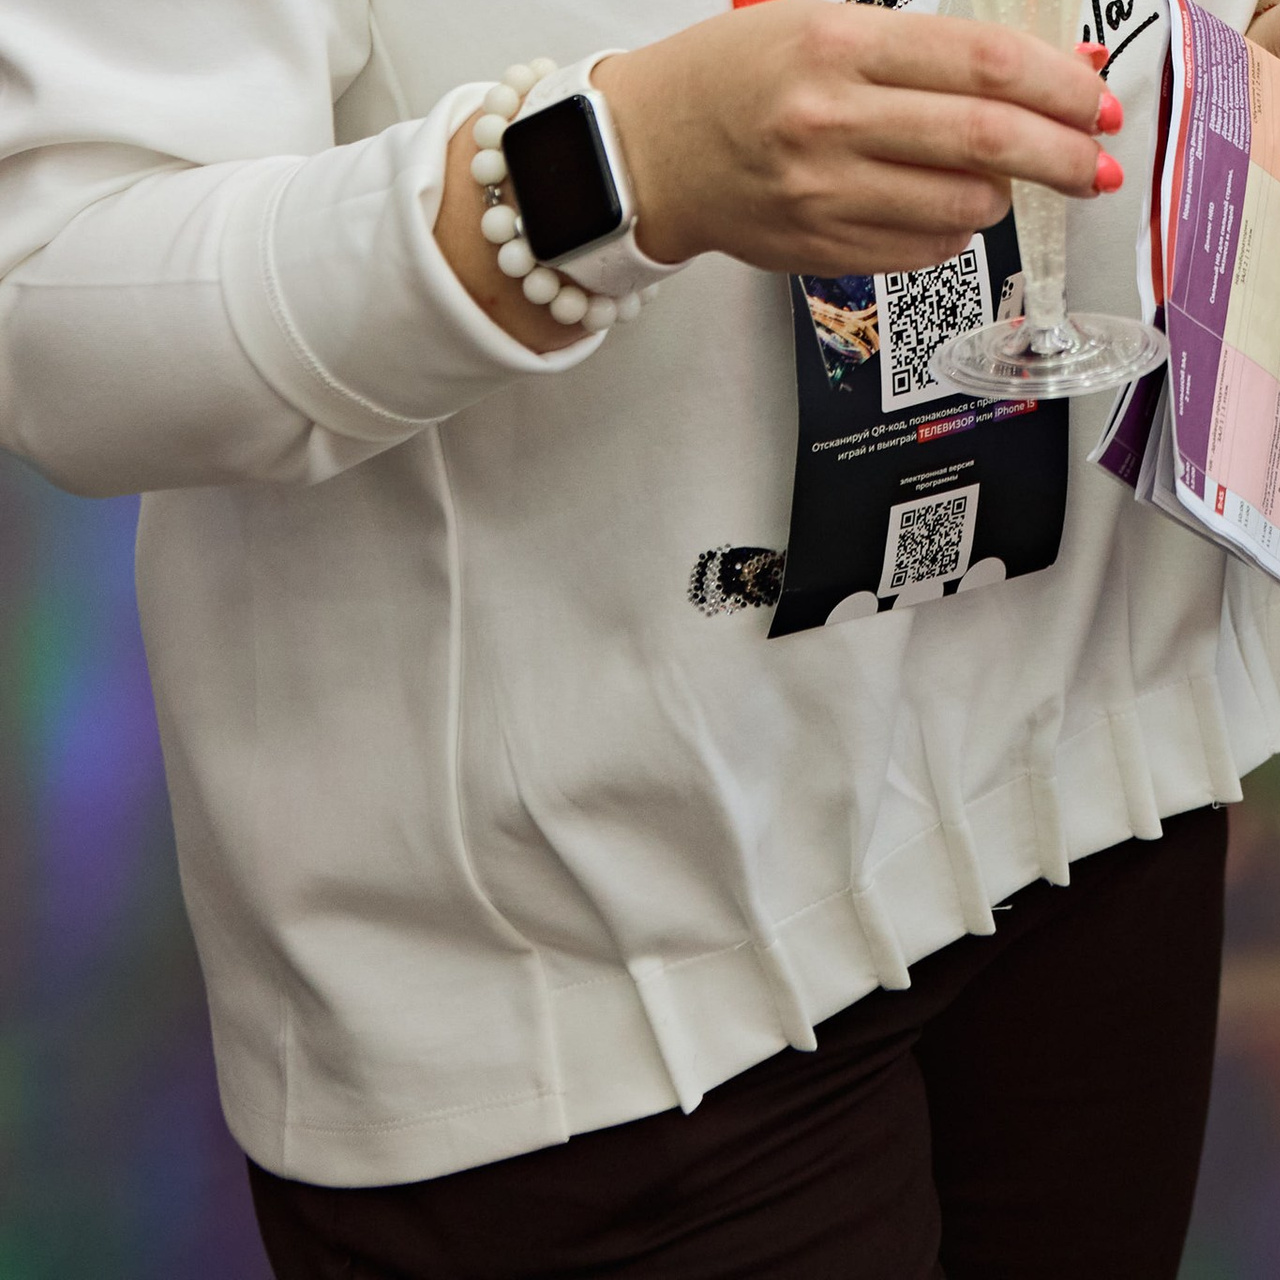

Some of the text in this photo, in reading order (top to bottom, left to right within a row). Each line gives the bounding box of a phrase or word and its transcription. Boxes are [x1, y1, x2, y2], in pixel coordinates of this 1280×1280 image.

[1181, 11, 1192, 88] ОТКРЫТИЕ ФОРУМА
[812, 429, 869, 452] Отсканируй
[871, 421, 907, 437] QR-код,
[909, 404, 968, 425] познакомься
[838, 445, 866, 460] играй
[877, 432, 917, 450] выиграй
[919, 416, 974, 438] ТЕЛЕВИЗОР
[976, 412, 993, 422] или
[995, 403, 1025, 417] iPhone
[1026, 398, 1035, 408] 15
[900, 460, 974, 485] электронная версия
[916, 475, 958, 490] программы
